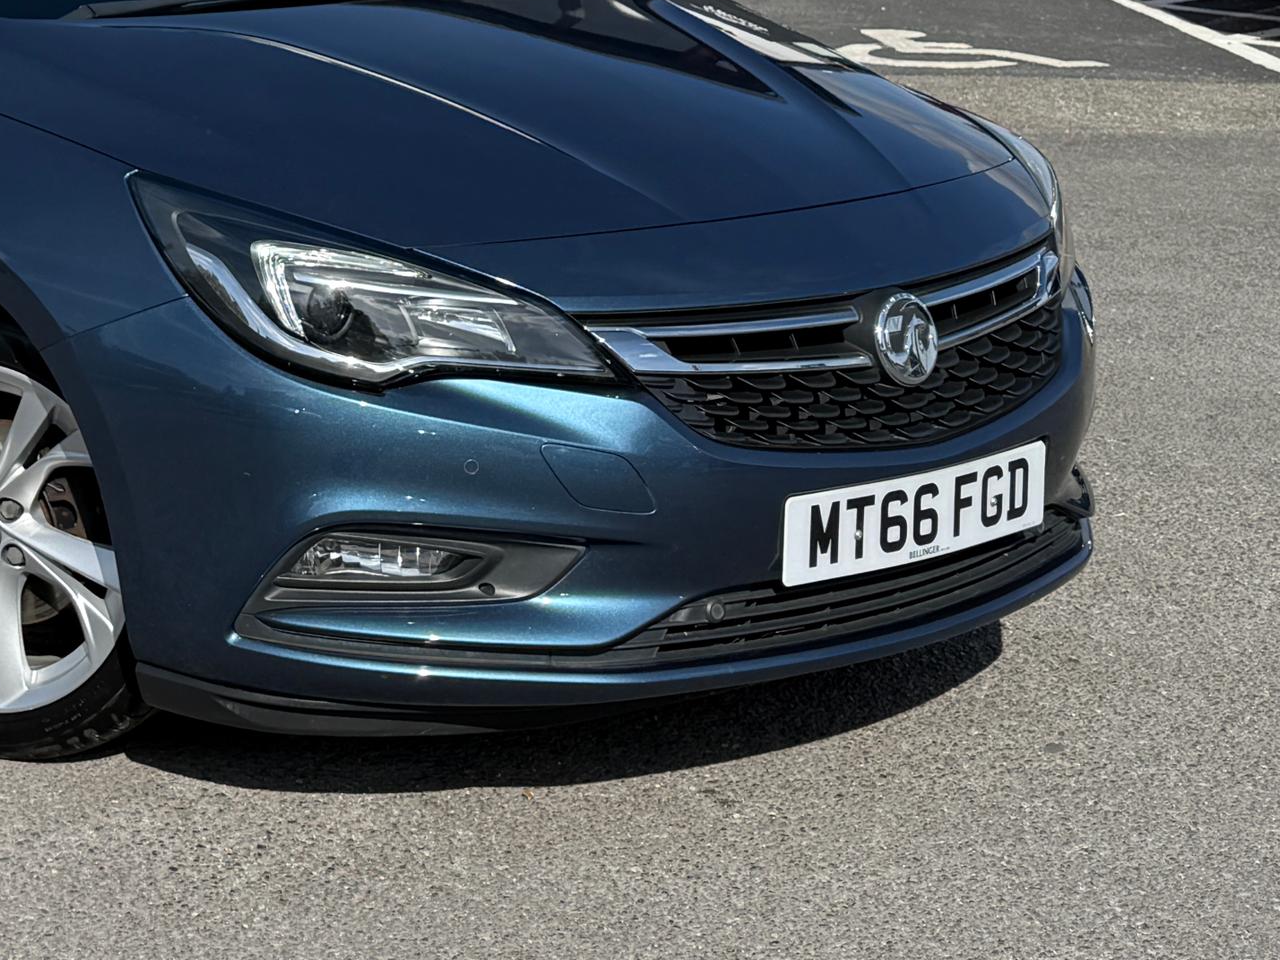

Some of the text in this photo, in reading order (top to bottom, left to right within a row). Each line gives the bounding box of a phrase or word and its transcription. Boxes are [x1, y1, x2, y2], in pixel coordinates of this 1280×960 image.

[808, 457, 1030, 569] MT66 FGD
[908, 544, 941, 560] BELLINGER
